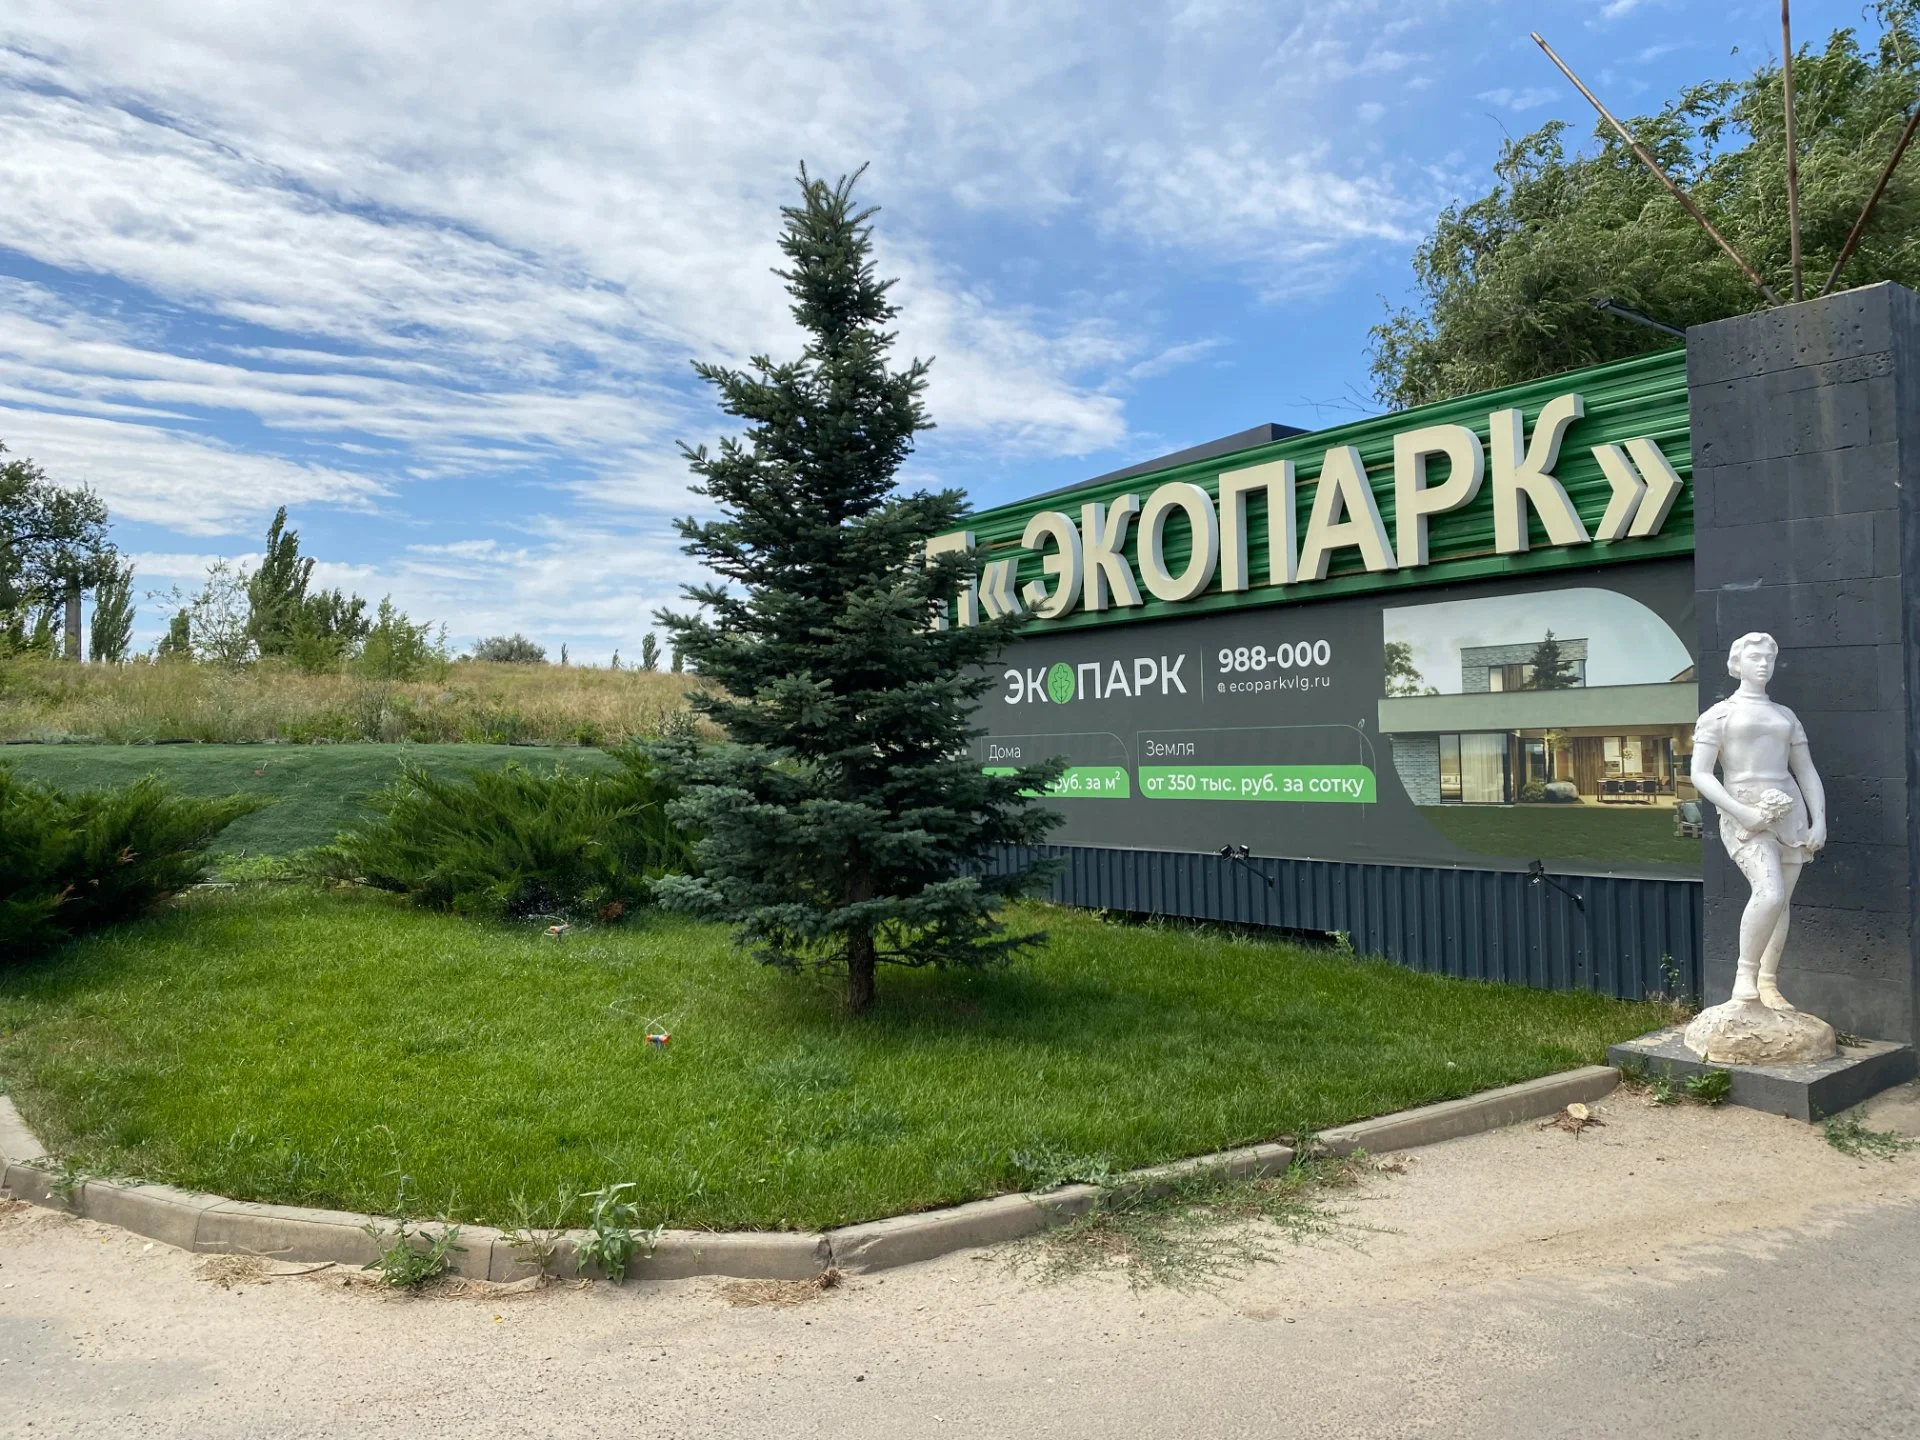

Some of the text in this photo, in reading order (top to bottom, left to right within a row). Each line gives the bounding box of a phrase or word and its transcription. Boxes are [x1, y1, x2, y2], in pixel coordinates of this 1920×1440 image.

[978, 392, 1683, 620] «ЭКОПАРК»
[1218, 639, 1331, 673] 988-000
[1003, 654, 1187, 705] ЭКОПАРК
[1229, 675, 1330, 694] ecoparkvlg.ru
[989, 744, 1021, 762] Дома
[1146, 740, 1195, 756] Земля
[1054, 773, 1082, 793] руб.
[1085, 777, 1100, 790] за
[1147, 773, 1365, 797] от 350 тыс. руб. за сотку
